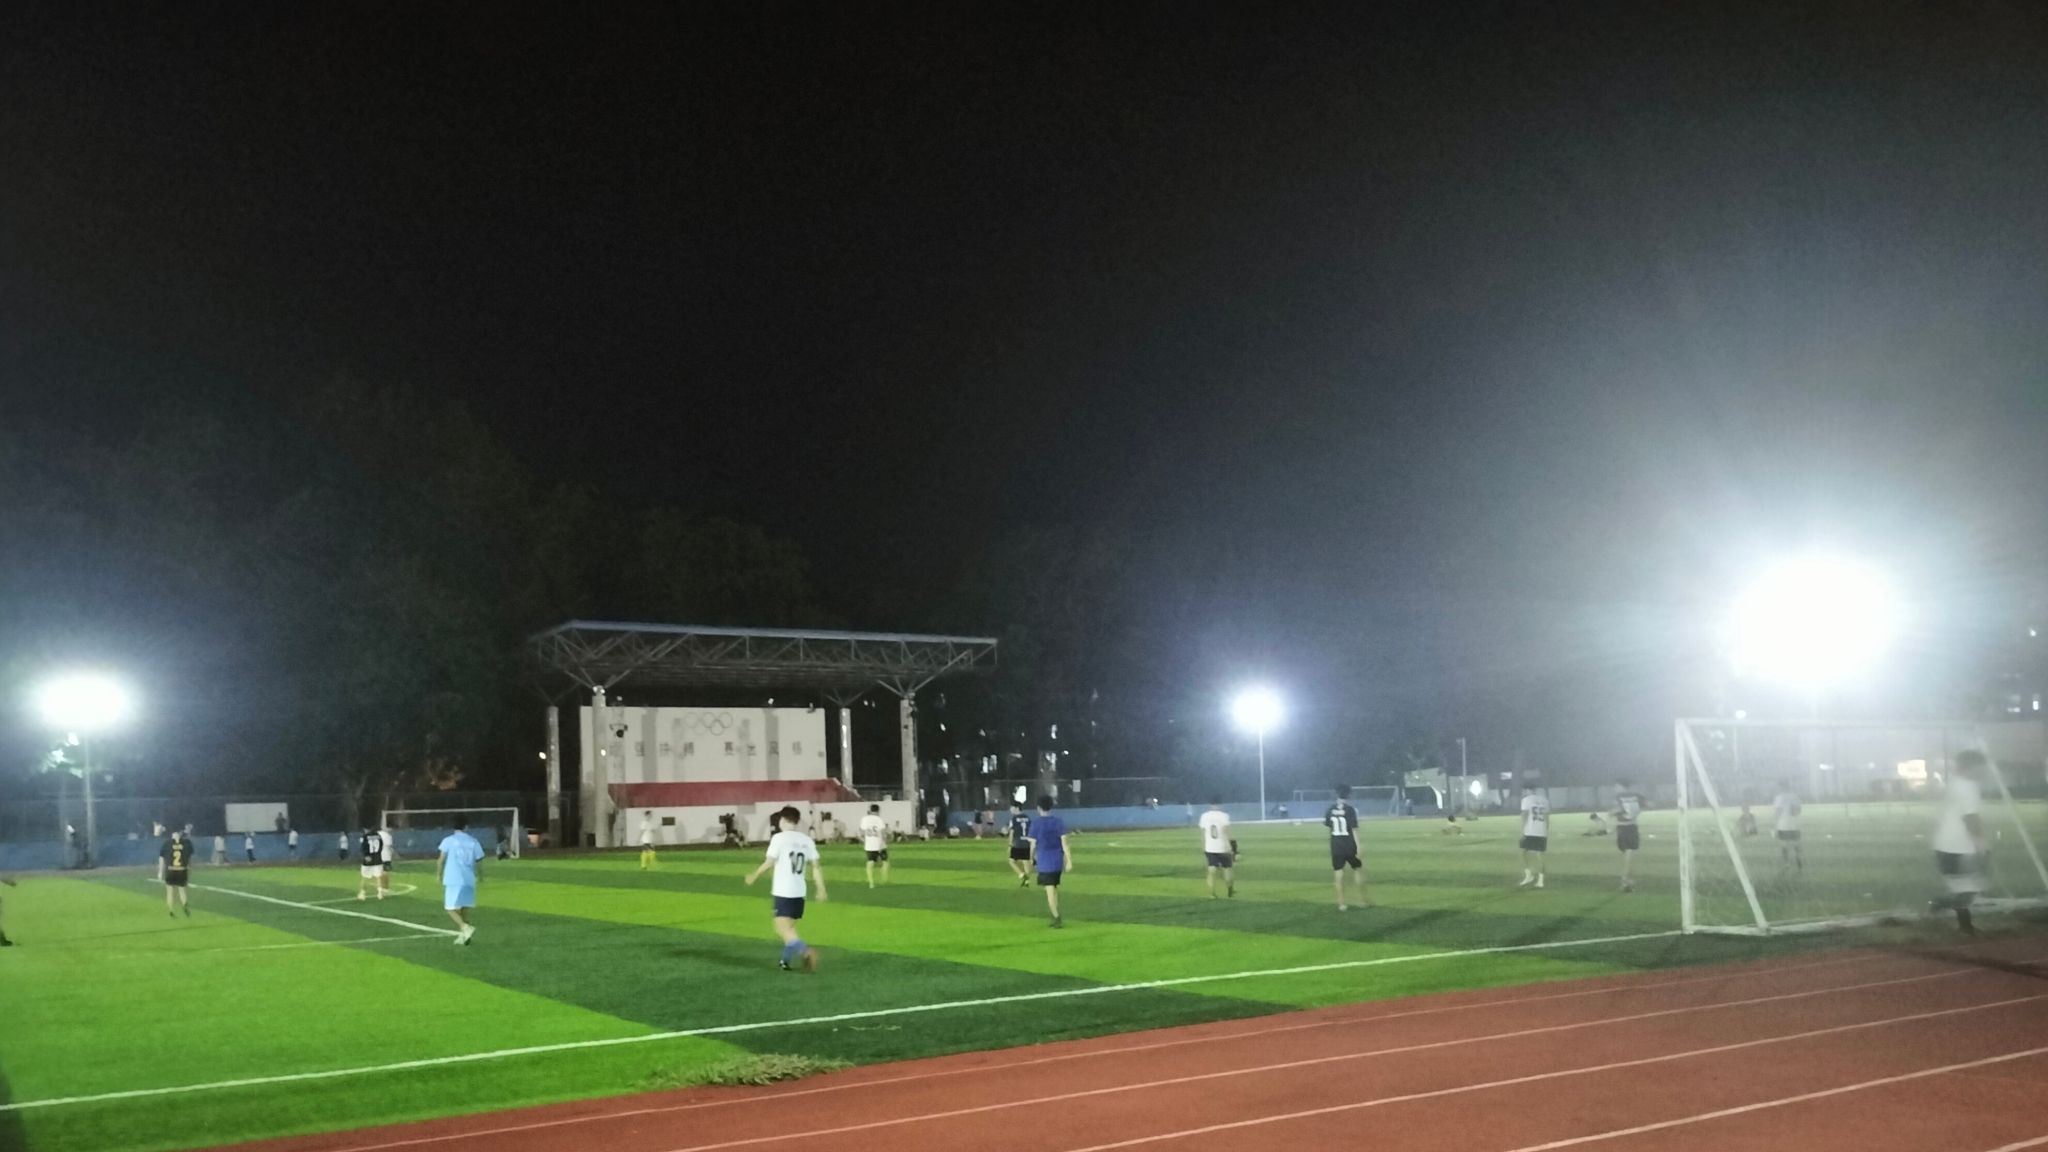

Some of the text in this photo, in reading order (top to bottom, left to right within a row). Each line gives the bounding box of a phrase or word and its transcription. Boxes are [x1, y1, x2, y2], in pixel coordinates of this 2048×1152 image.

[1330, 816, 1349, 836] 11
[173, 850, 182, 866] 2
[789, 851, 805, 875] 10
